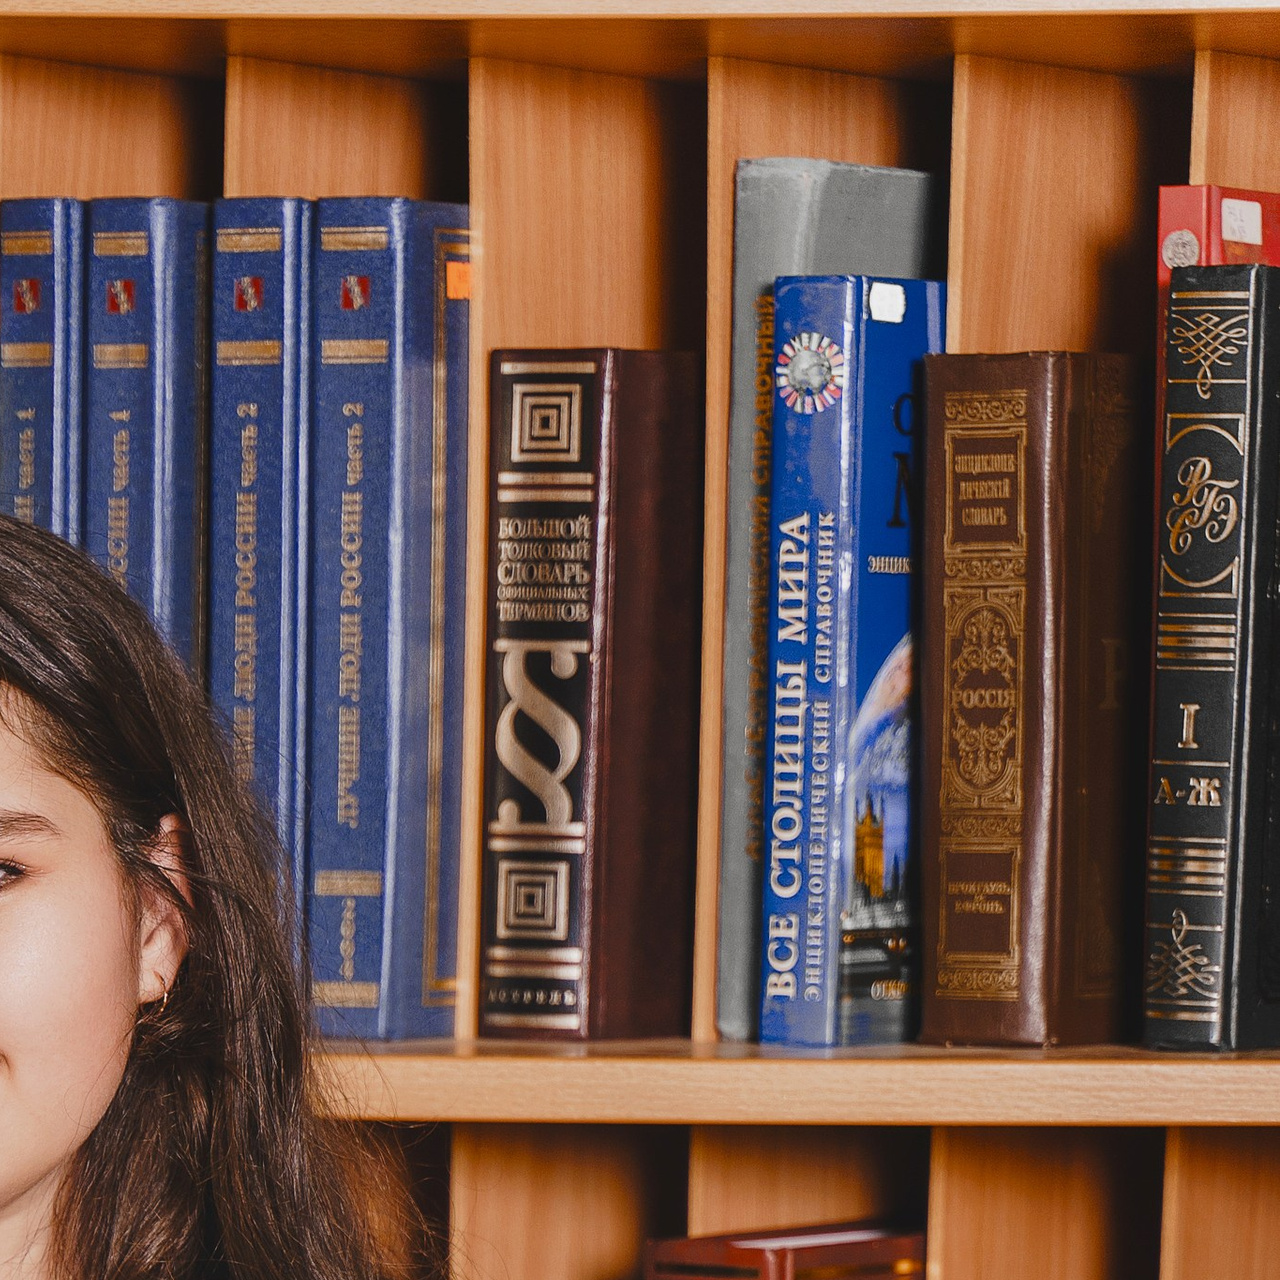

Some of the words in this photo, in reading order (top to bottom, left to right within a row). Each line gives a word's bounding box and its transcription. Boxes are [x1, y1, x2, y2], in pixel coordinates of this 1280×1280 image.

[237, 402, 258, 418] 2
[343, 402, 365, 417] 2
[498, 514, 591, 540] БОЛЬШОЙ
[962, 506, 1007, 526] СЛОВАРЬ
[236, 491, 258, 607] РОССИИ
[340, 491, 364, 607] РОССИИ
[498, 539, 591, 561] ТОЛКОВЫЙ
[497, 561, 590, 585] СЛОВАРЬ
[777, 511, 811, 645] МИРА
[497, 584, 589, 602] ОФИЦИАЛЬНЫХ
[814, 511, 836, 684] СПРАВОЧНИК
[496, 602, 589, 622] ТЕРМИНОВ
[339, 614, 363, 702] ЛЮДИ
[769, 660, 809, 899] СТОЛИЦЫ
[1154, 776, 1221, 807] А-Ж
[804, 700, 831, 1002] ЭНЦИКЛОПЕДИЧЕСКИЙ
[766, 912, 799, 999] ВСЕ
